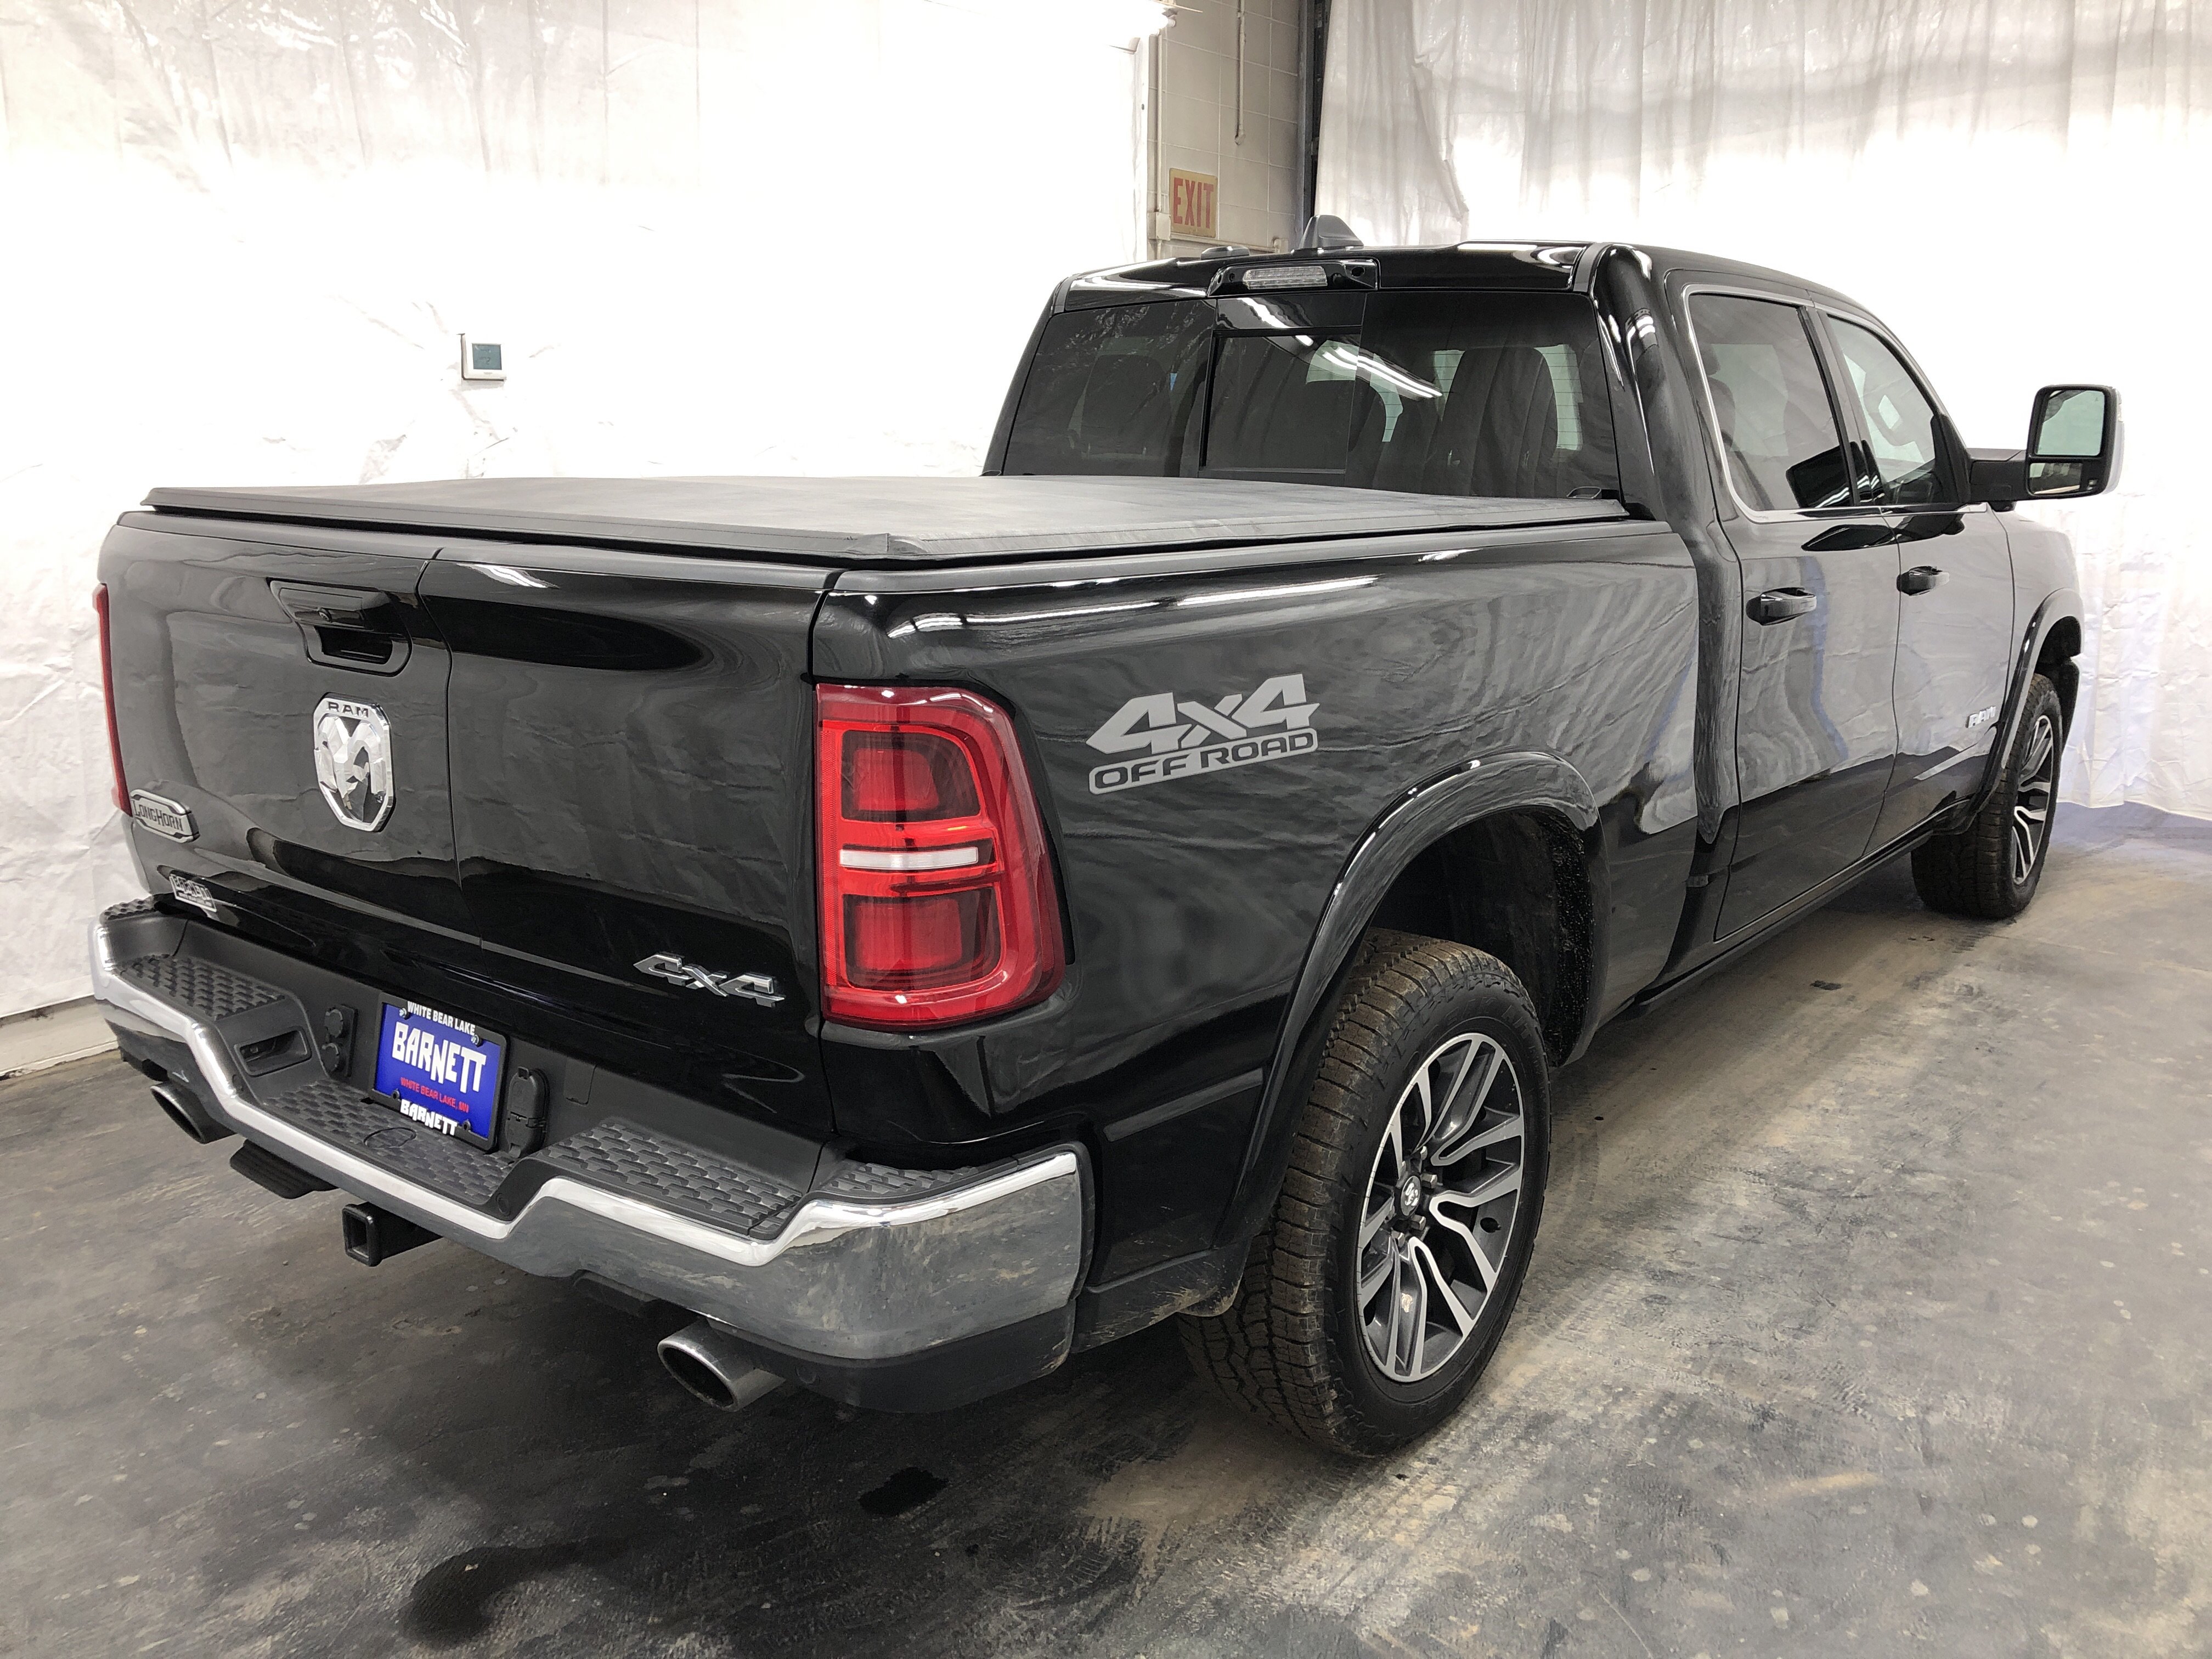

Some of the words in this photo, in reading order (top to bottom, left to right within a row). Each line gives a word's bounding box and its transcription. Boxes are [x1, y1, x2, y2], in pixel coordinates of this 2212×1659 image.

[1173, 177, 1214, 229] EXIT
[328, 701, 369, 718] RAM
[1966, 706, 1996, 729] RAM
[1095, 753, 1193, 789] OFF
[1200, 732, 1314, 768] ROAD
[132, 800, 184, 832] LONGHORN
[408, 1001, 432, 1020] WHITE
[433, 1009, 453, 1027] BEAR
[455, 1018, 476, 1036] LAKE
[392, 1022, 487, 1093] BARNETT
[400, 1077, 420, 1093] WHITE
[420, 1085, 439, 1101] BEAR
[439, 1091, 458, 1110] LAKE,
[459, 1102, 469, 1113] MN
[400, 1098, 458, 1136] BARNETT
